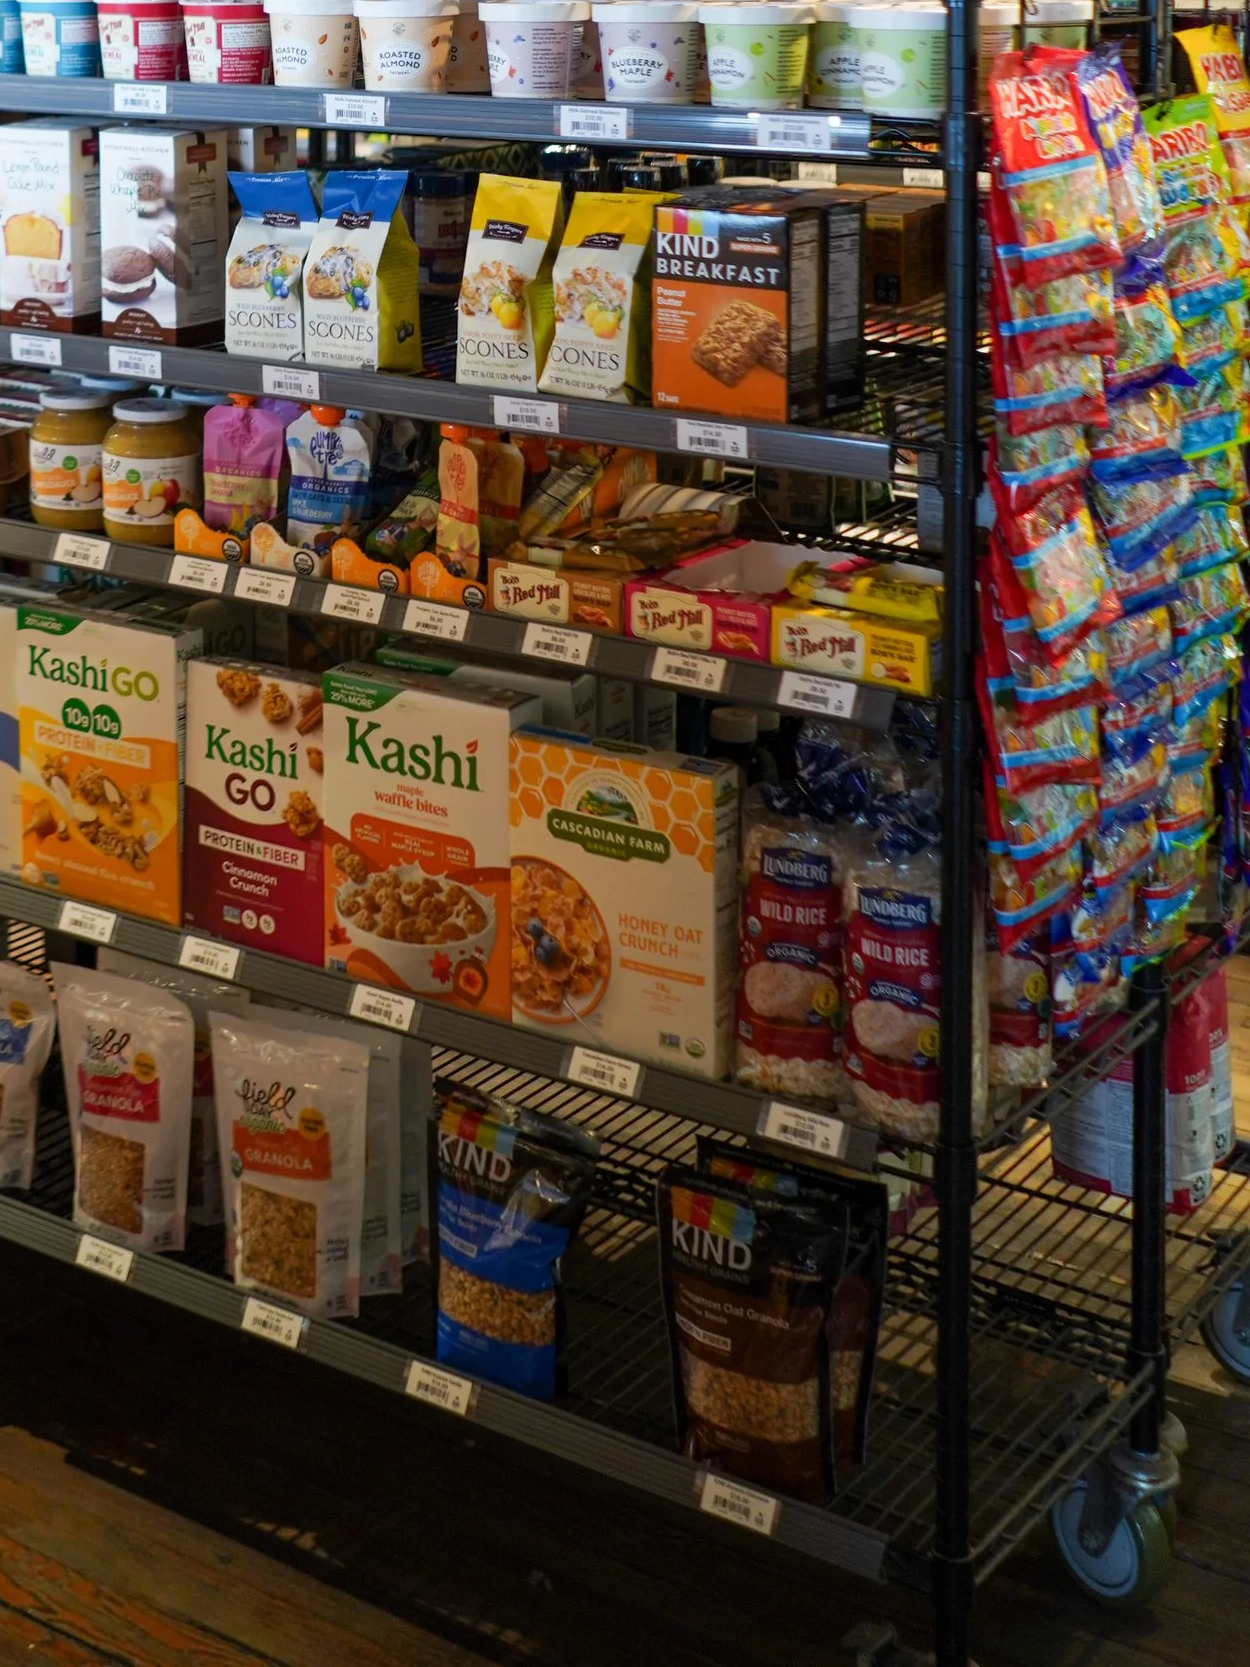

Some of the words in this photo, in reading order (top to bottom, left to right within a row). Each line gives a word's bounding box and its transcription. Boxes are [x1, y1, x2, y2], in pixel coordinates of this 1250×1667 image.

[379, 51, 421, 60] ROASTED
[380, 60, 420, 69] ALMOND
[611, 61, 664, 70] BLUEBERRY
[829, 58, 860, 67] APPLE
[619, 68, 653, 77] MAPLE
[142, 146, 170, 154] KITCHEN
[1149, 121, 1209, 164] ARIBO
[2, 160, 31, 174] Lemon
[31, 157, 60, 174] Pound
[6, 176, 31, 191] Cake
[35, 179, 56, 191] Mix
[489, 223, 503, 231] Sticky
[504, 225, 523, 235] Fingers
[763, 233, 772, 244] 5
[656, 232, 720, 259] KIND
[656, 258, 780, 285] BREAKFAST
[657, 287, 686, 298] Peanut
[657, 297, 683, 307] Butter
[228, 310, 297, 329] SCONES
[308, 320, 374, 342] SCONES
[459, 337, 529, 360] SCONES
[551, 345, 620, 371] CONES
[657, 392, 666, 402] 12
[317, 451, 343, 465] tree
[302, 482, 350, 494] ORGANICS
[513, 586, 535, 605] Red
[536, 583, 561, 605] Mill
[652, 610, 676, 630] Red
[677, 609, 703, 631] Mill
[800, 637, 827, 657] Red
[828, 636, 855, 659] Mill
[897, 653, 915, 662] BAR
[28, 644, 109, 693] Kashi
[111, 666, 159, 702] GO
[65, 707, 89, 731] 10g
[93, 712, 120, 738] 10g
[38, 726, 98, 751] PROTEIN
[104, 742, 147, 765] FIBER
[205, 724, 299, 780] Kashi
[345, 715, 481, 793] Kashi
[225, 772, 276, 812] GO
[396, 783, 425, 799] maple
[374, 789, 414, 810] waffle
[416, 798, 449, 818] bites
[551, 817, 626, 847] CASCADIAN
[628, 836, 666, 855] FARM
[203, 829, 255, 855] PROTEIN
[263, 846, 299, 866] FIBER
[414, 846, 435, 857] SYRUP
[446, 845, 470, 857] WHOLE
[446, 852, 469, 863] GRAIN
[221, 860, 278, 886] Cinnamon
[763, 854, 828, 884] LUNDBERG
[119, 873, 155, 891] crunch
[229, 877, 270, 897] Crunch
[760, 899, 793, 922] WILD
[794, 905, 827, 926] RICE
[860, 895, 927, 923] LUNDBERG
[618, 913, 669, 939] HONEY
[674, 924, 704, 945] OAT
[619, 933, 680, 959] CRUNCH
[766, 946, 816, 965] ORGANIC
[861, 937, 894, 964] WILD
[895, 944, 930, 968] RICE
[869, 986, 920, 1007] ORGANIC
[83, 1089, 145, 1113] GRANOLA
[244, 1148, 314, 1171] GRANOLA
[437, 1130, 512, 1184] KIND
[672, 1217, 753, 1271] KIND
[710, 1266, 751, 1285] GRAINS
[723, 1302, 744, 1319] Oat
[746, 1308, 791, 1331] Granola
